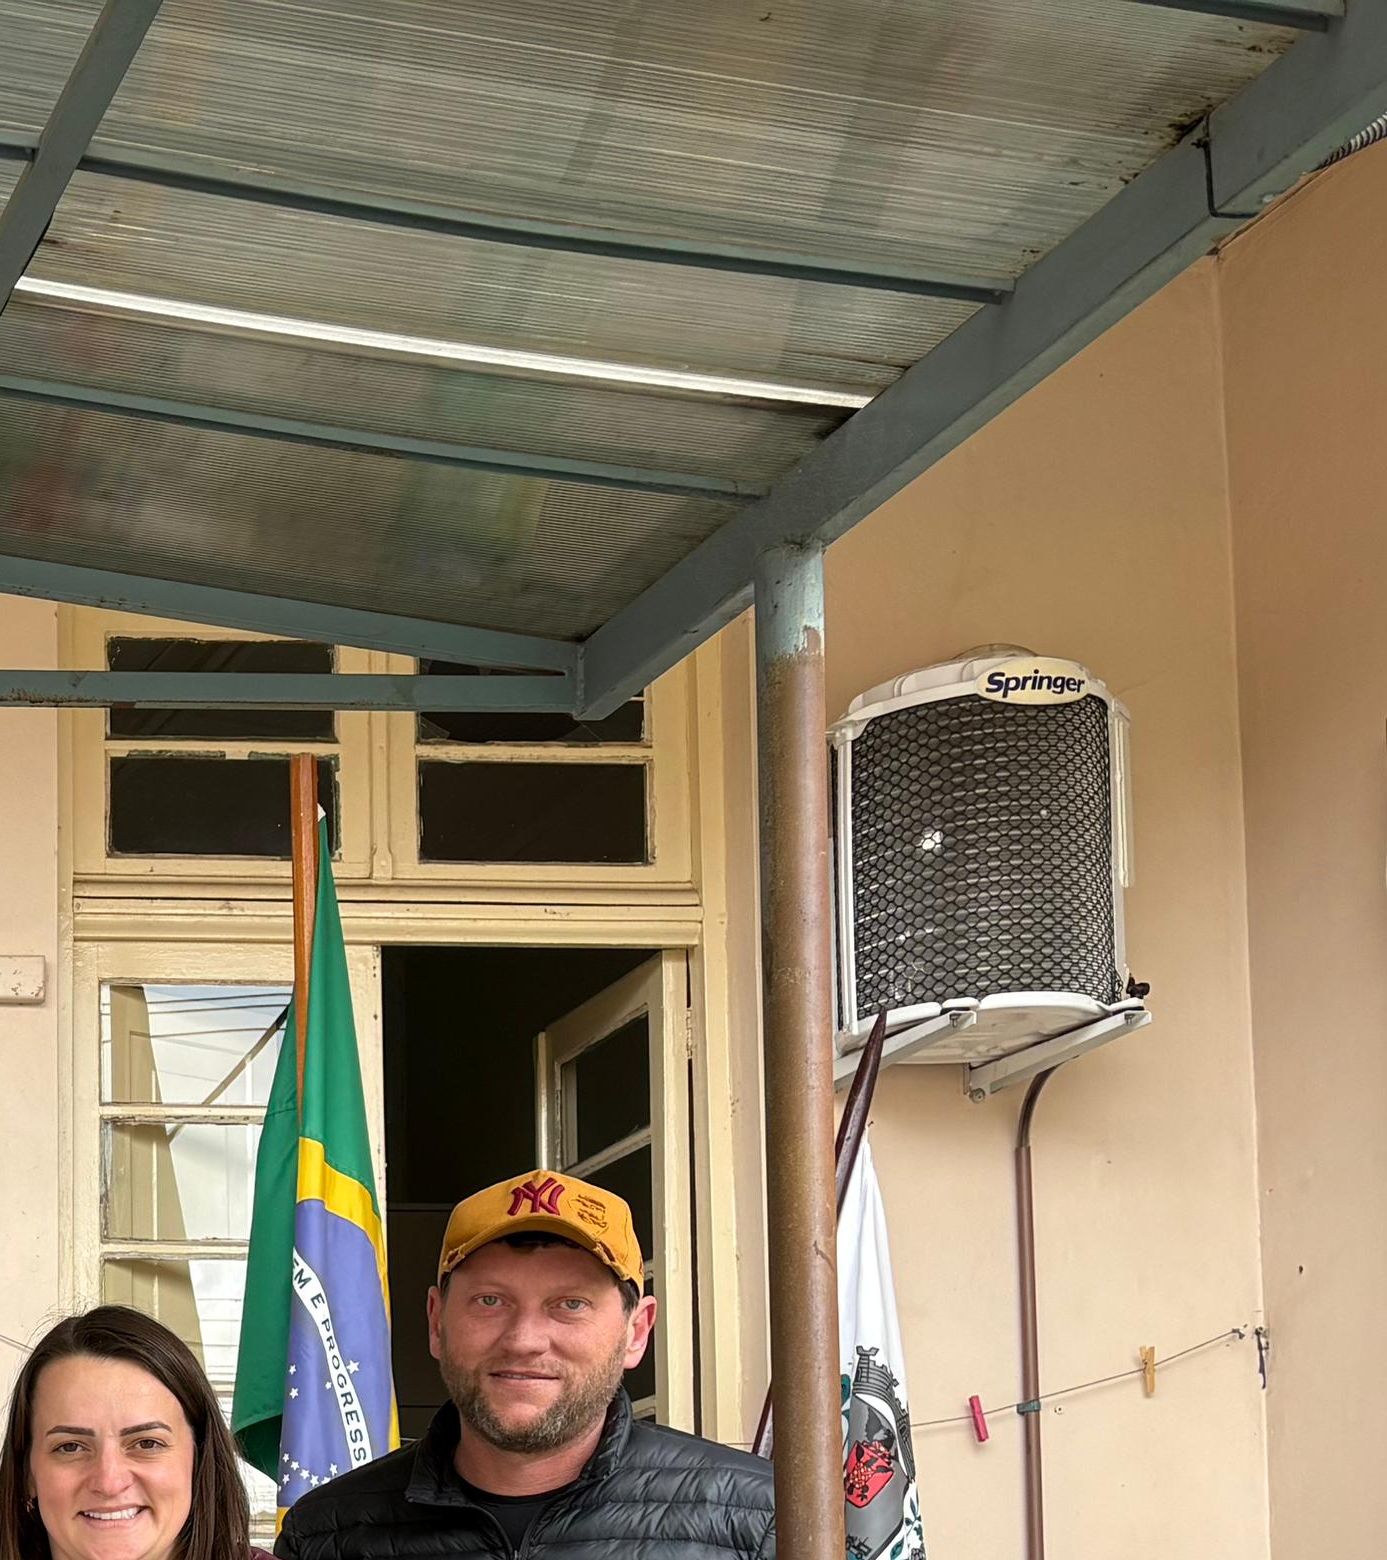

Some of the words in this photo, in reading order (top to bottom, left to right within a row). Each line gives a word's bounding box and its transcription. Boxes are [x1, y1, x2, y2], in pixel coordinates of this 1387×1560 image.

[985, 668, 1085, 699] Springer
[507, 1177, 566, 1217] NY
[310, 1292, 326, 1309] E
